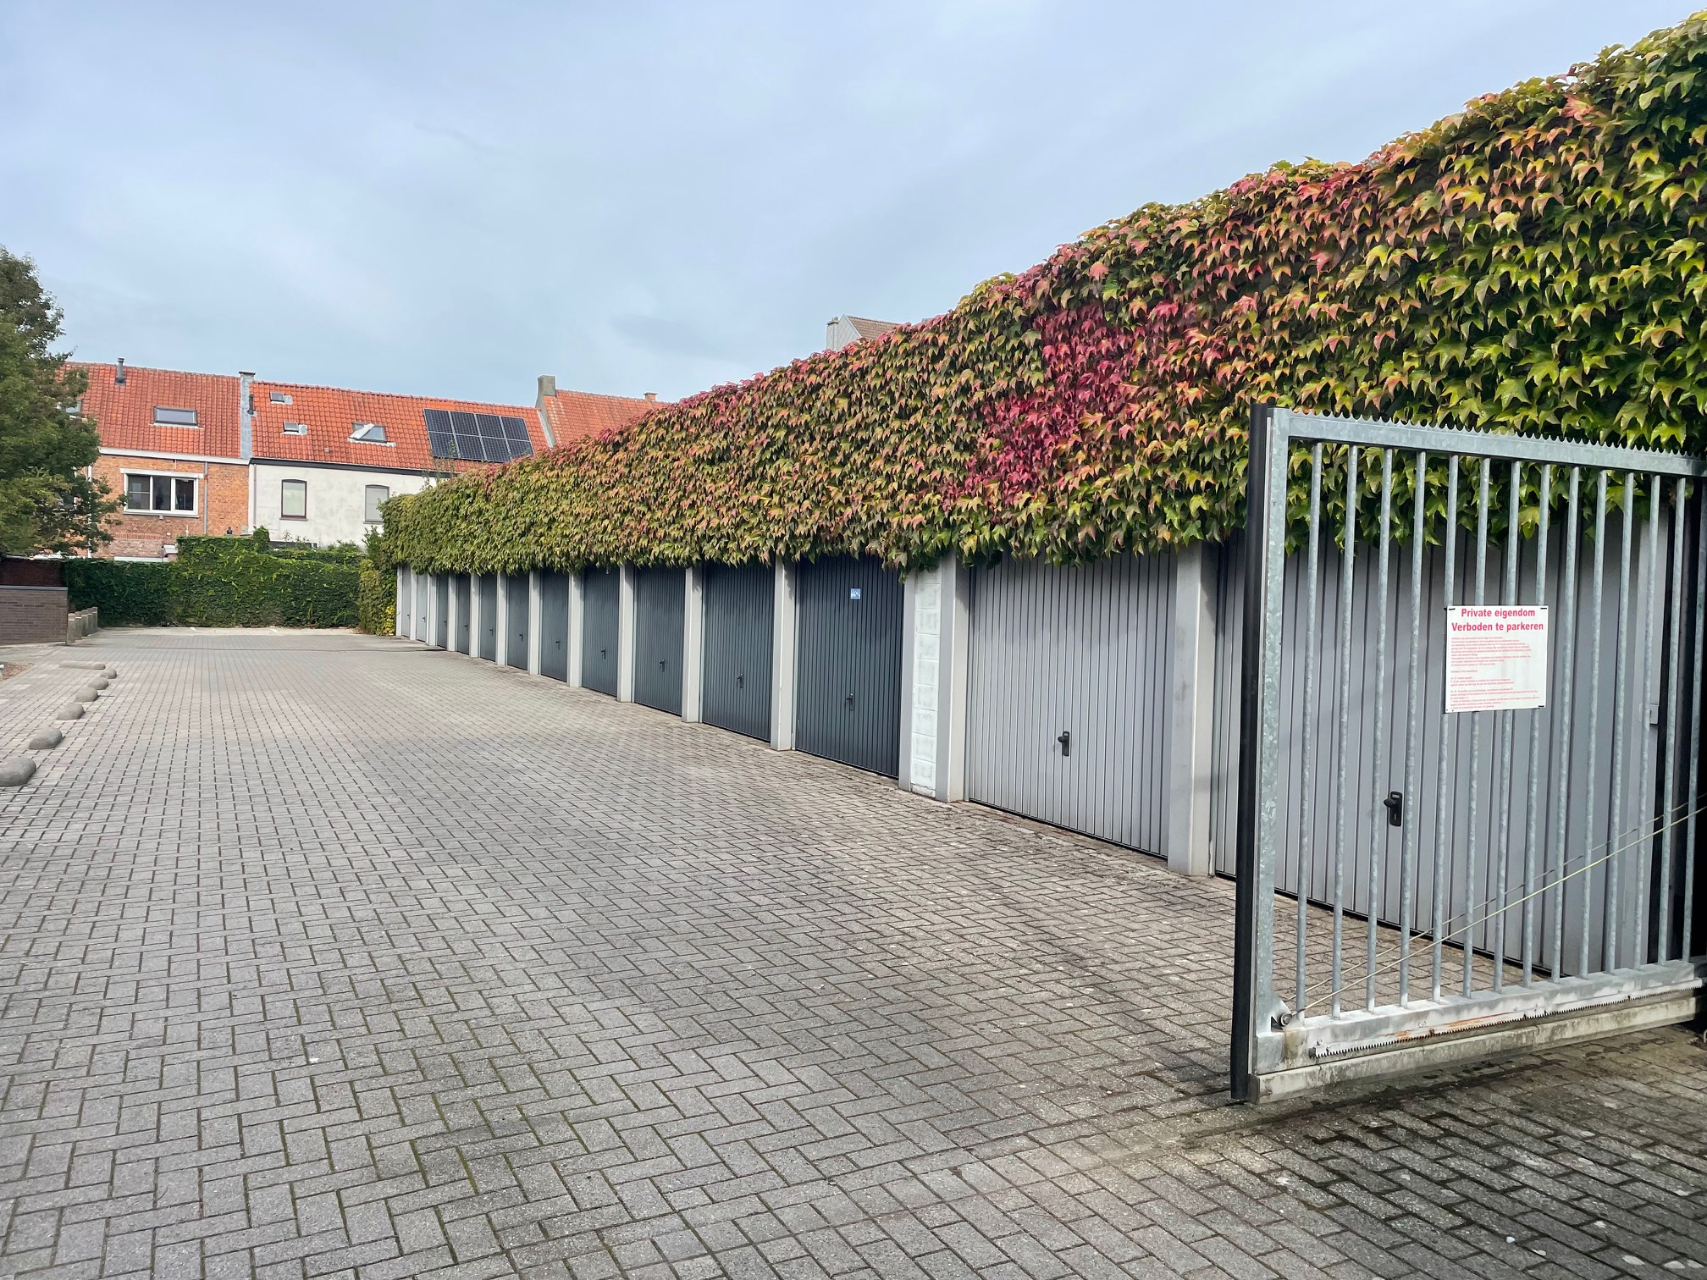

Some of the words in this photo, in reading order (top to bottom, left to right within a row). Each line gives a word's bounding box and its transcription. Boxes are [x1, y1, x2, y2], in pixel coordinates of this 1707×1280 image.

[1461, 608, 1492, 617] Private
[1494, 608, 1535, 619] eigendom
[1451, 622, 1492, 631] Verboden
[1495, 623, 1504, 631] te
[1506, 622, 1544, 632] parkeren
